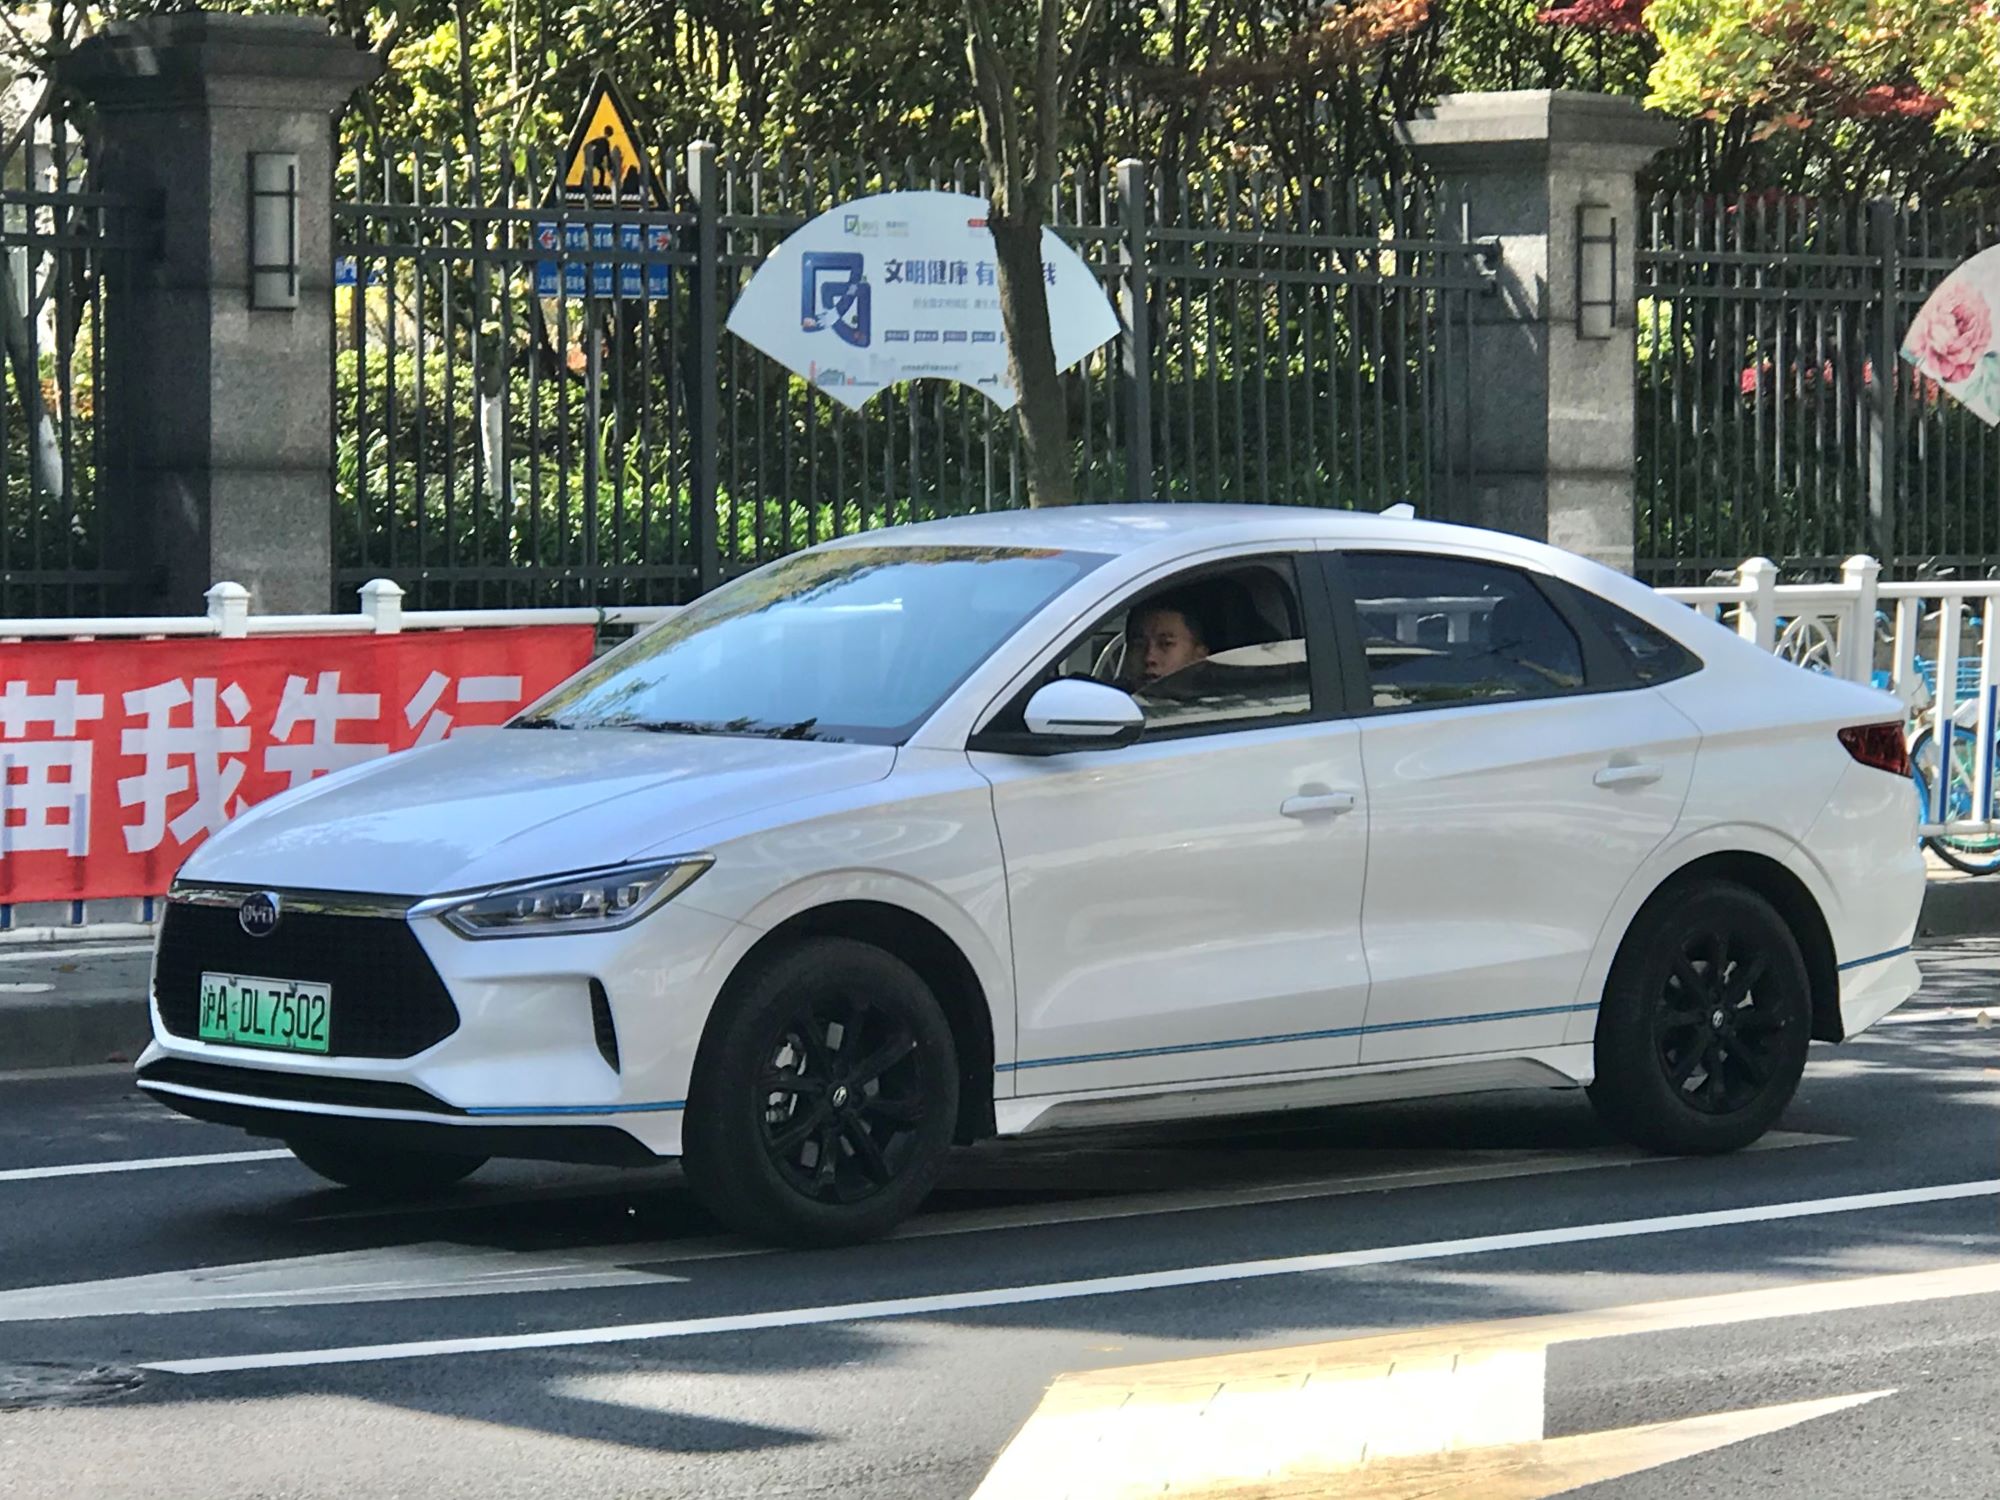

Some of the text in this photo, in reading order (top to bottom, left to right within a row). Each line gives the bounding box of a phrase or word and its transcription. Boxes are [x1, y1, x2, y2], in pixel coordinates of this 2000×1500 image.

[884, 258, 968, 286] 文明健康
[243, 905, 274, 924] BYD
[239, 987, 326, 1041] DL7502
